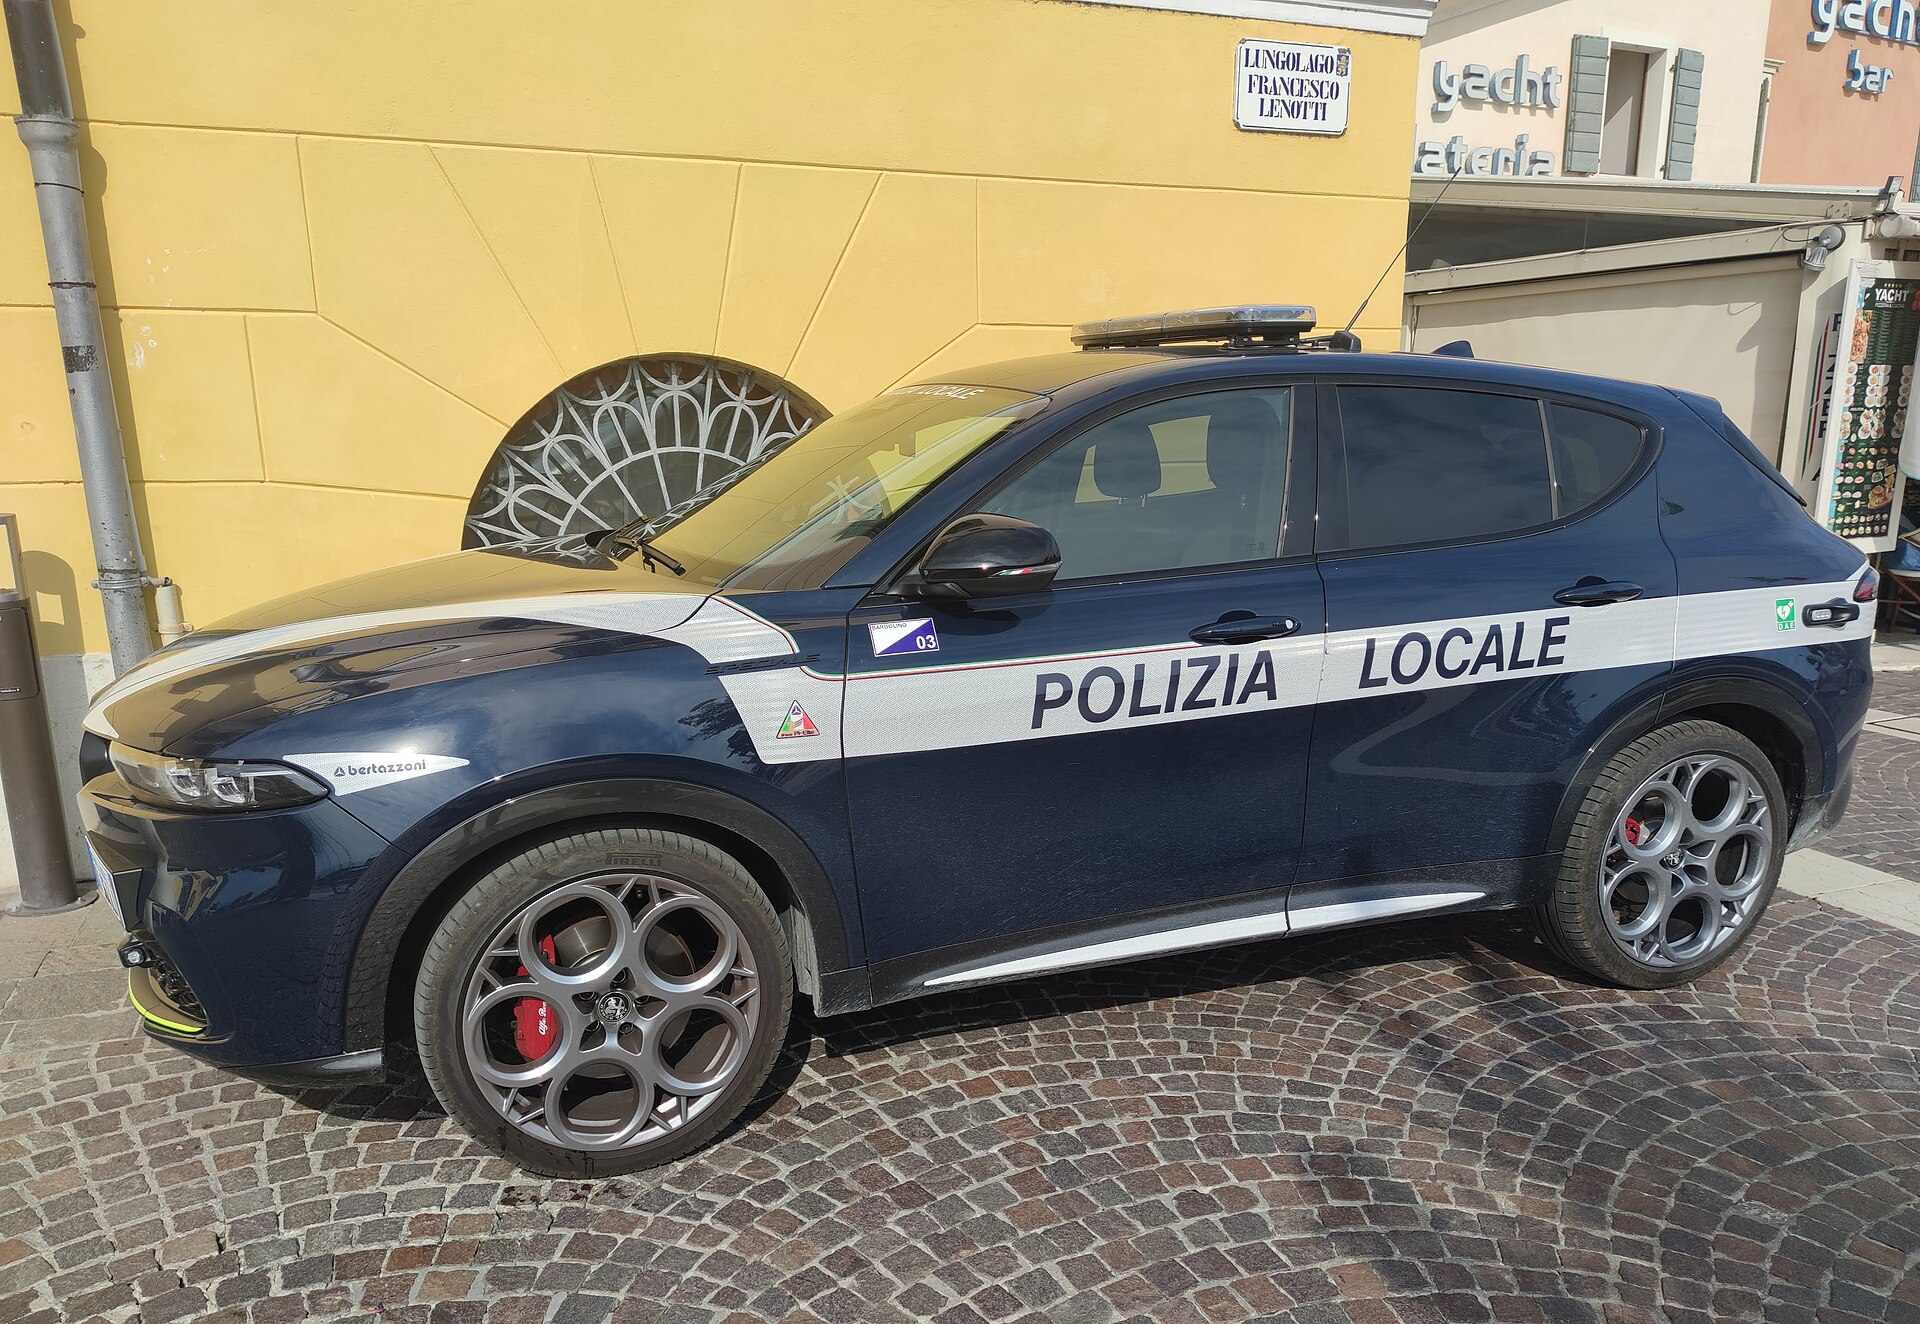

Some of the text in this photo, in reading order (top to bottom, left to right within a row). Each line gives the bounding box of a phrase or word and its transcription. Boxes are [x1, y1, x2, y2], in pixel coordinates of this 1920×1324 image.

[1244, 48, 1334, 74] LUNGOLAGO
[1844, 48, 1894, 94] bar
[1248, 74, 1340, 100] FRANCESCO
[1431, 53, 1562, 112] yacht
[1259, 98, 1328, 121] LENOTTI
[1875, 288, 1909, 302] YACHT
[871, 621, 907, 631] BARDOLINO
[915, 634, 936, 650] 03
[1031, 616, 1571, 729] POLIZIA LOCALE
[347, 759, 426, 776] bertazzoni
[605, 853, 662, 867] PIRELLI
